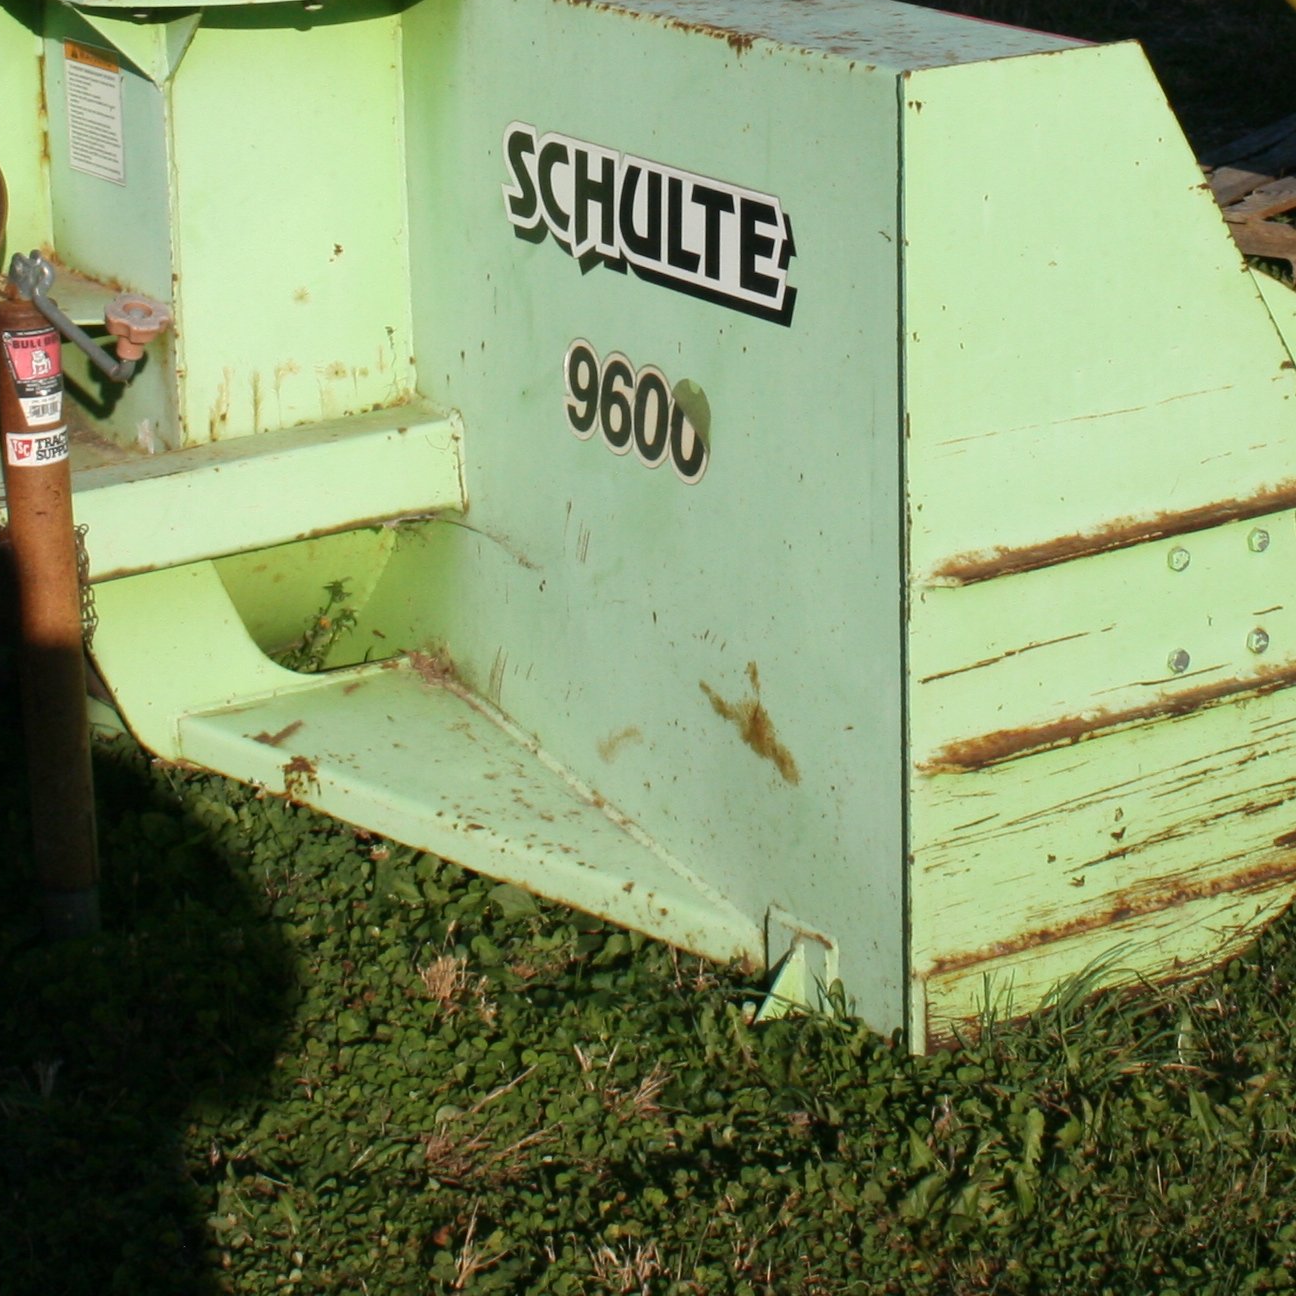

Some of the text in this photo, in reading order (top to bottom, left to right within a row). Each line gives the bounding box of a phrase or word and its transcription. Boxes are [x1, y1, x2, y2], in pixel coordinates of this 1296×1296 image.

[505, 127, 786, 302] SCHULTE
[12, 334, 59, 349] BULLDO
[12, 439, 30, 457] TSC
